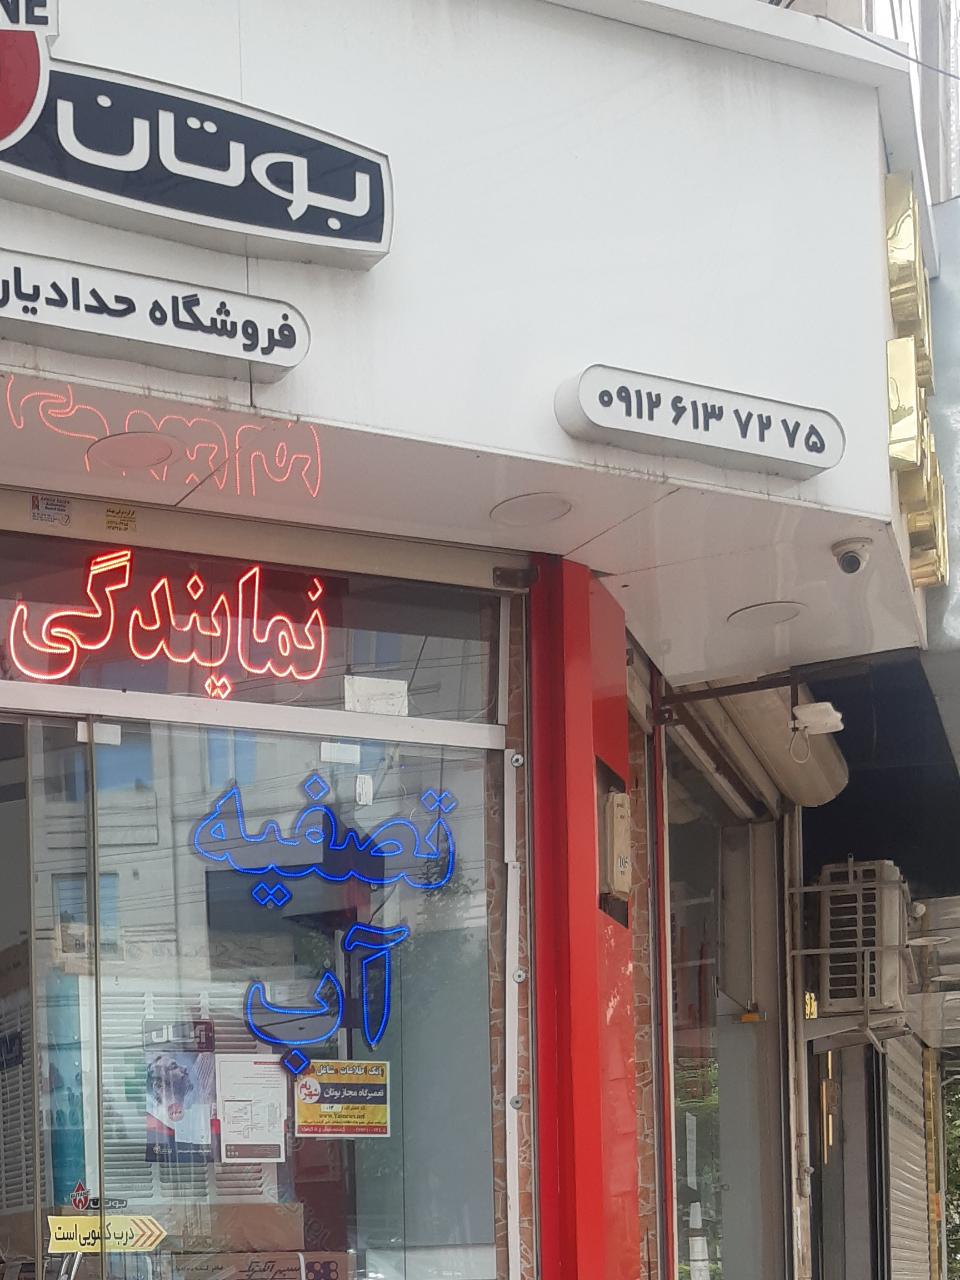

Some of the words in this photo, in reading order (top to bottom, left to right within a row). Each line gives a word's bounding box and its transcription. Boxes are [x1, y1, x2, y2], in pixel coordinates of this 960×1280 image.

[57, 94, 371, 230] بوتان
[149, 293, 297, 355] فروشگاه
[598, 386, 662, 420] ۰۹۱۲
[671, 403, 724, 432] ۶۱۳
[733, 409, 772, 443] ۷۲
[781, 419, 826, 454] ۷۵
[10, 551, 327, 699] نمایندگی
[194, 772, 457, 908] تصفیه
[244, 925, 409, 1075] آب
[54, 1223, 78, 1241] است
[90, 1198, 127, 1209] بوتن
[114, 1227, 135, 1247] درب
